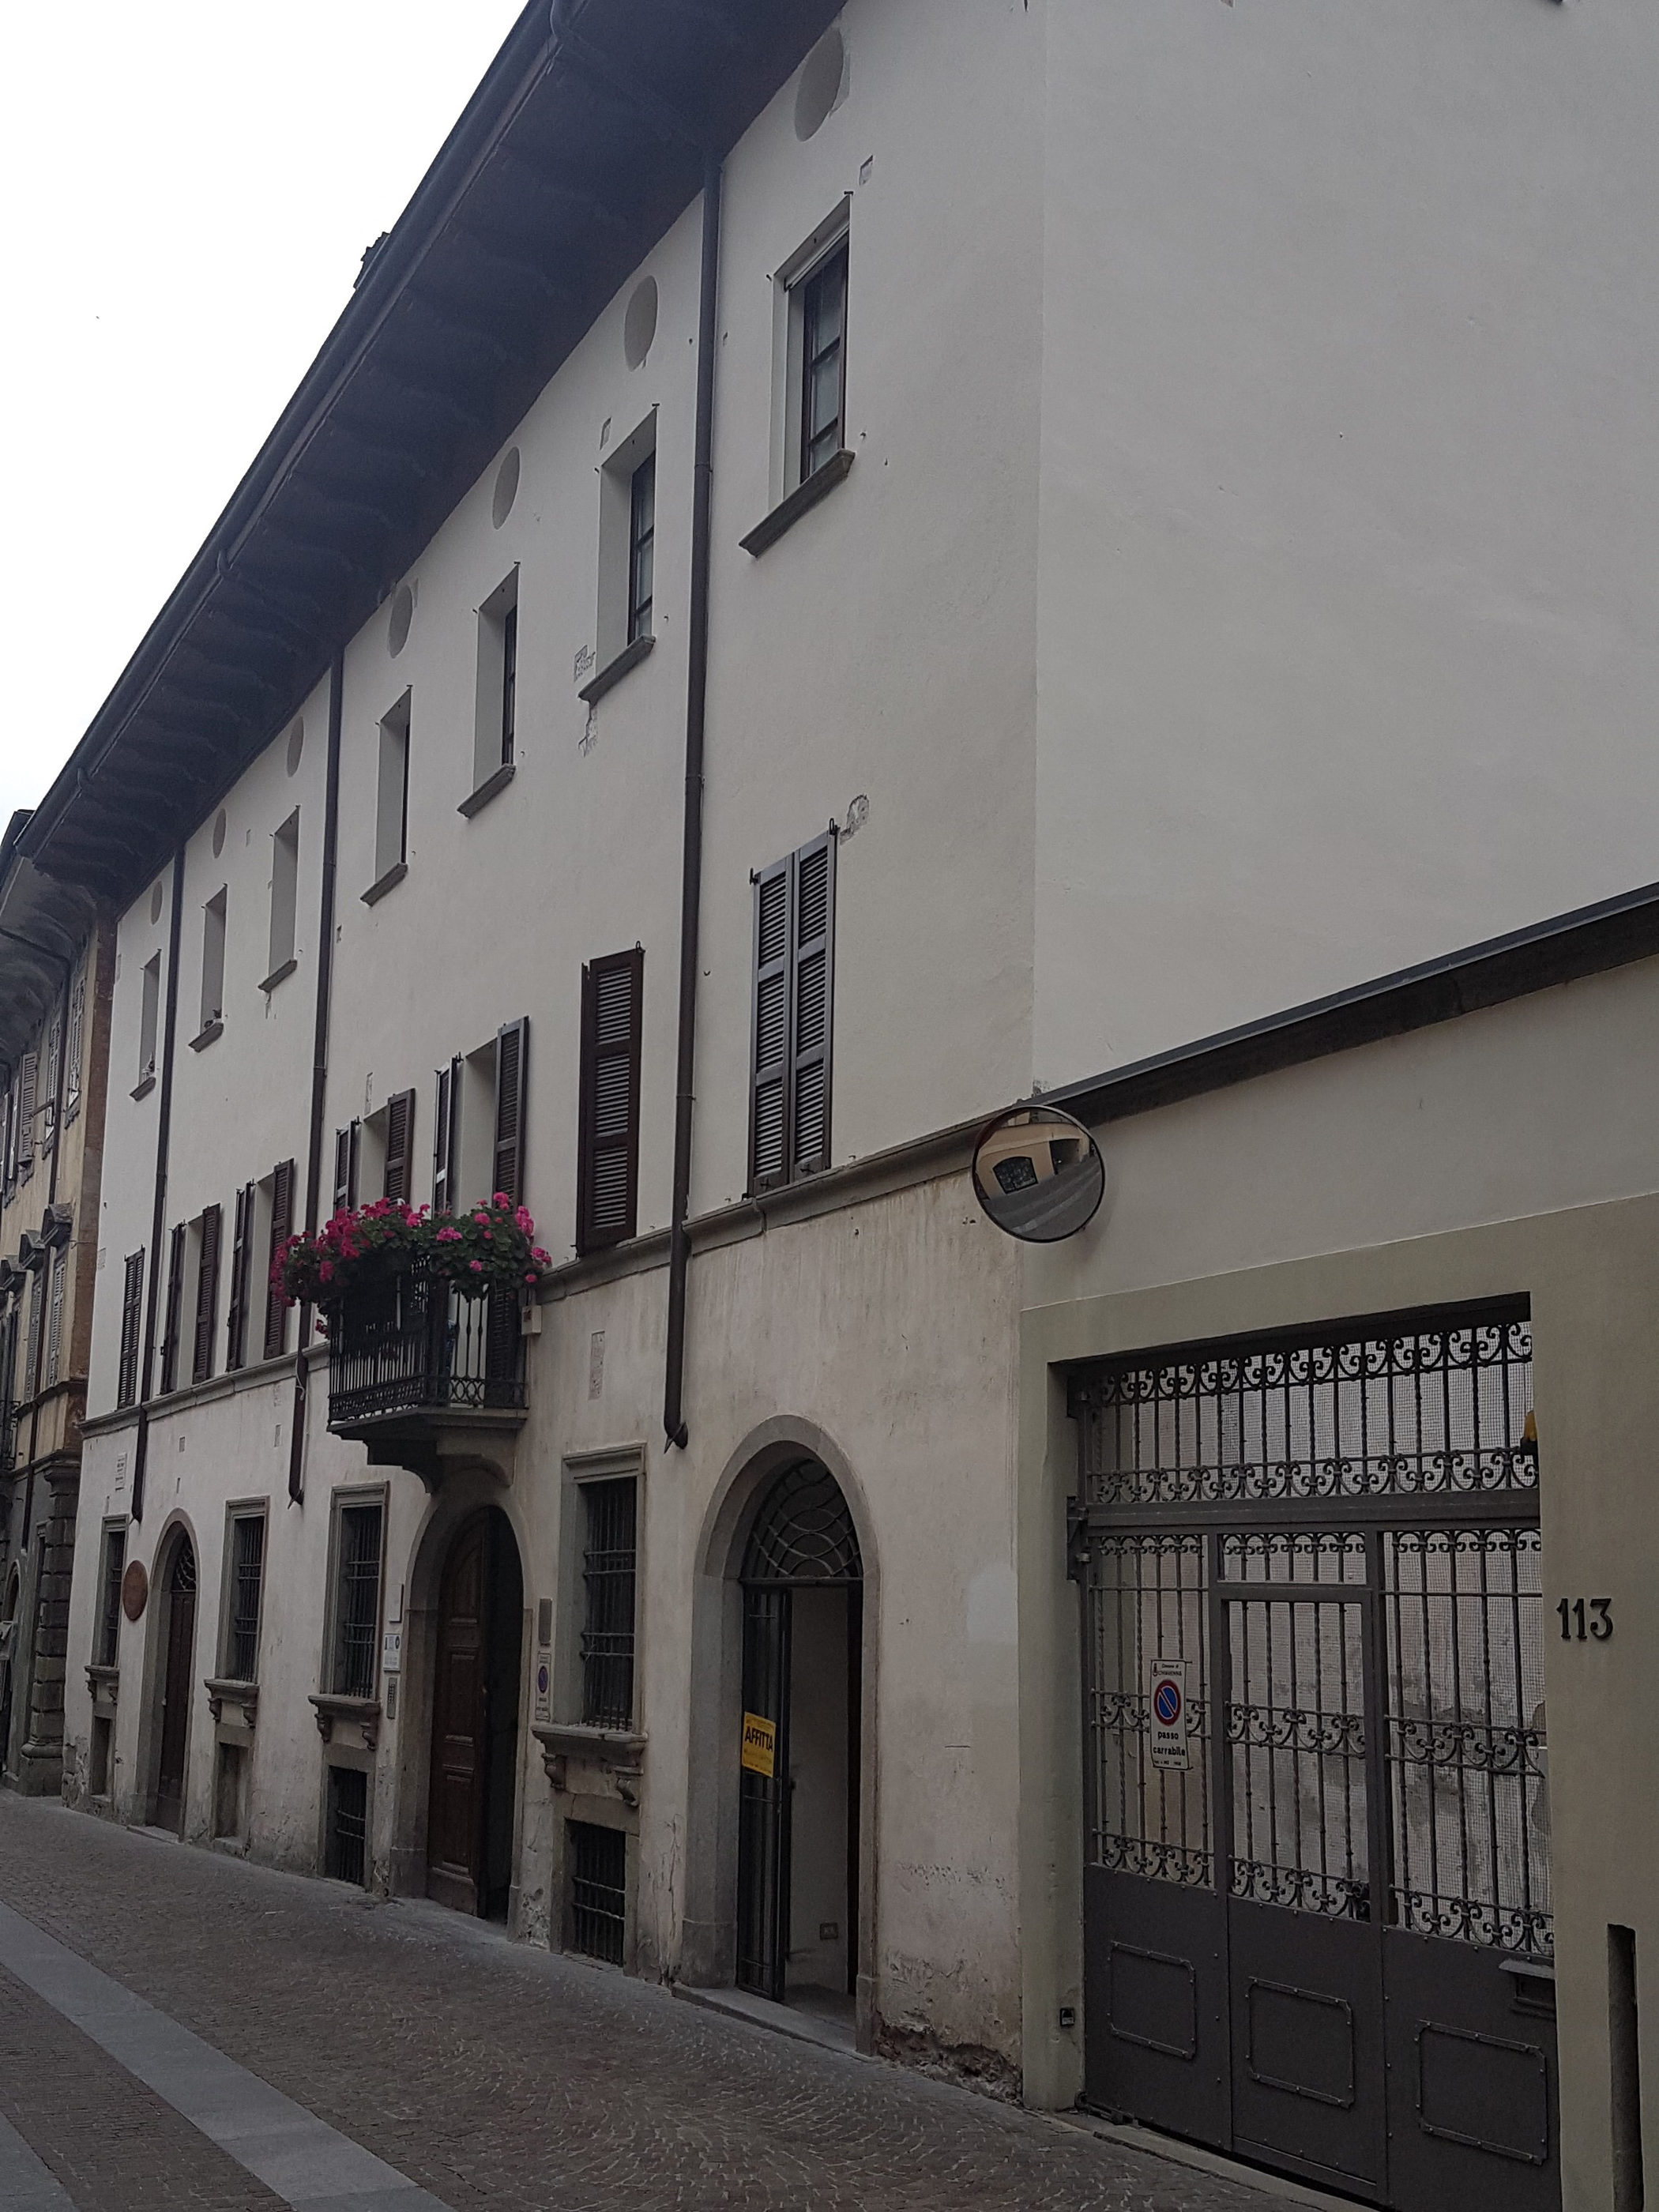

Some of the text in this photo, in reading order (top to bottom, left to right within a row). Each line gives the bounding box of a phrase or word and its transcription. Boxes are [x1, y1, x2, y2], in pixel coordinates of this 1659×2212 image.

[1556, 1597, 1613, 1639] 113
[744, 1725, 773, 1752] AFFITTA
[1157, 1729, 1179, 1740] passo
[1153, 1746, 1186, 1757] carrabile
